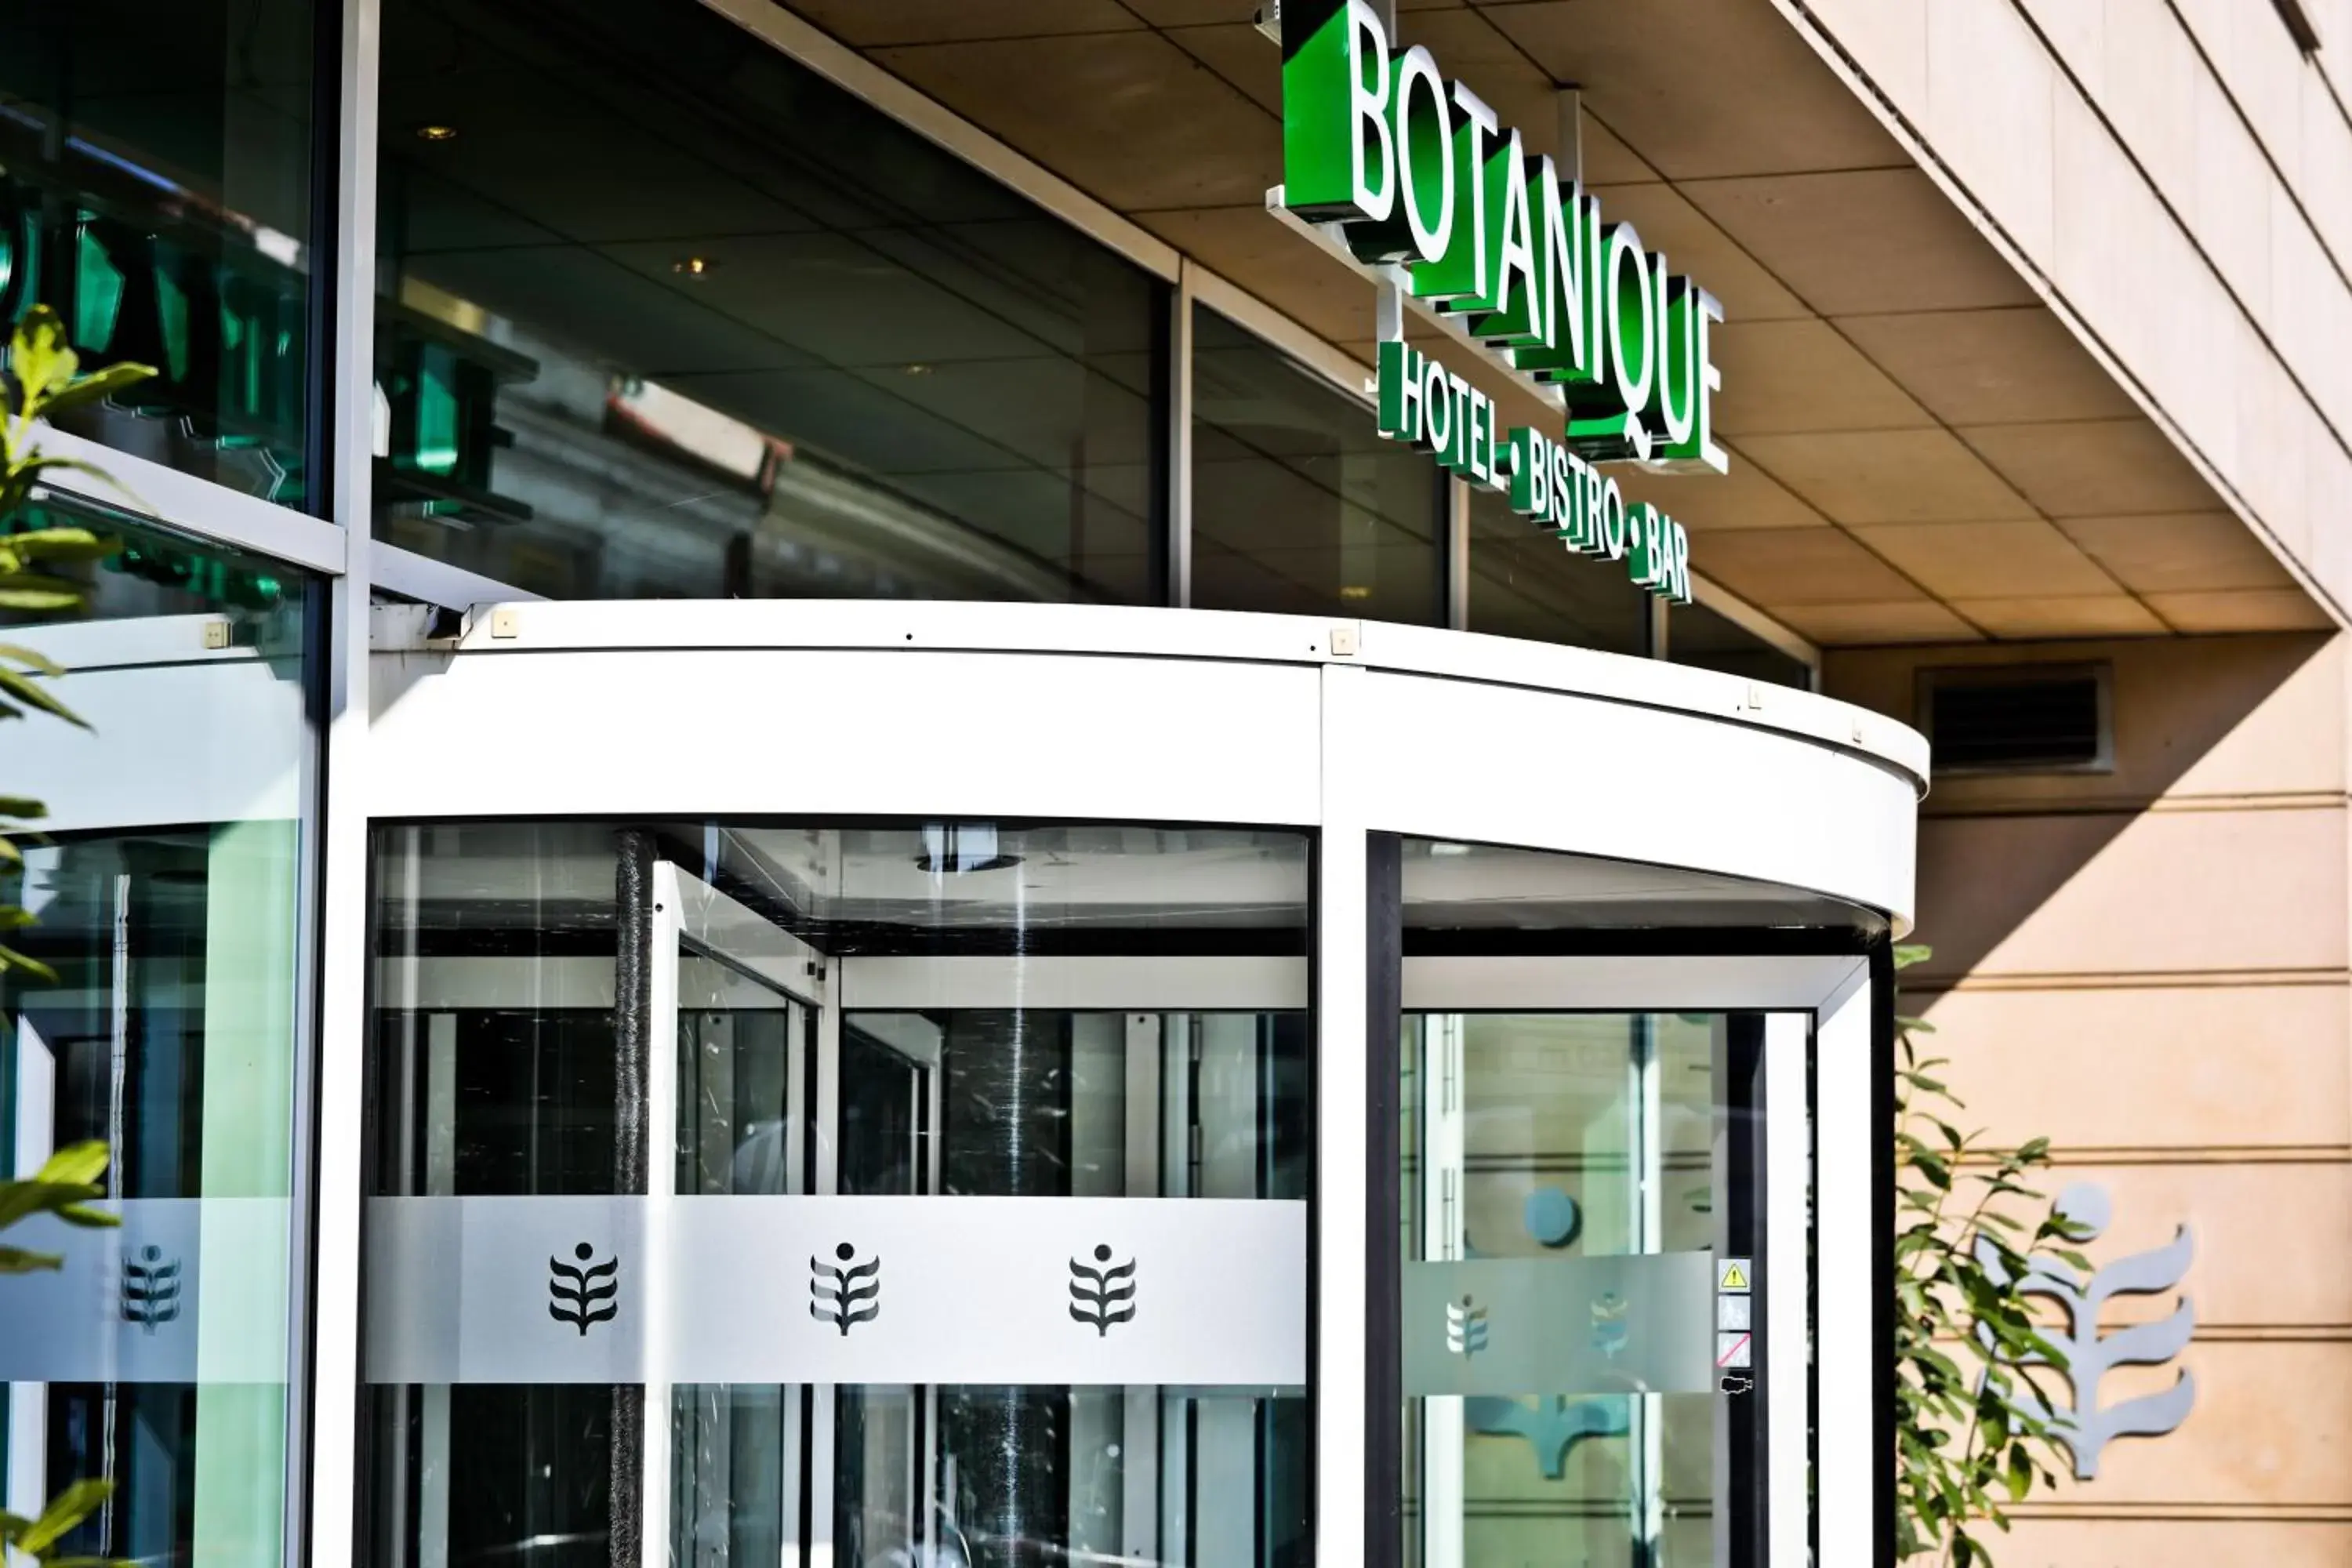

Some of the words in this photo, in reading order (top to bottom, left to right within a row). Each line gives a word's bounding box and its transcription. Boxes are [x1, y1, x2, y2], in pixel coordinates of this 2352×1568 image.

[1347, 0, 1729, 475] BOTANIQUE
[1399, 341, 1505, 492] HOTEL
[1529, 426, 1624, 561] BISTRO
[1644, 502, 1693, 604] BAR
